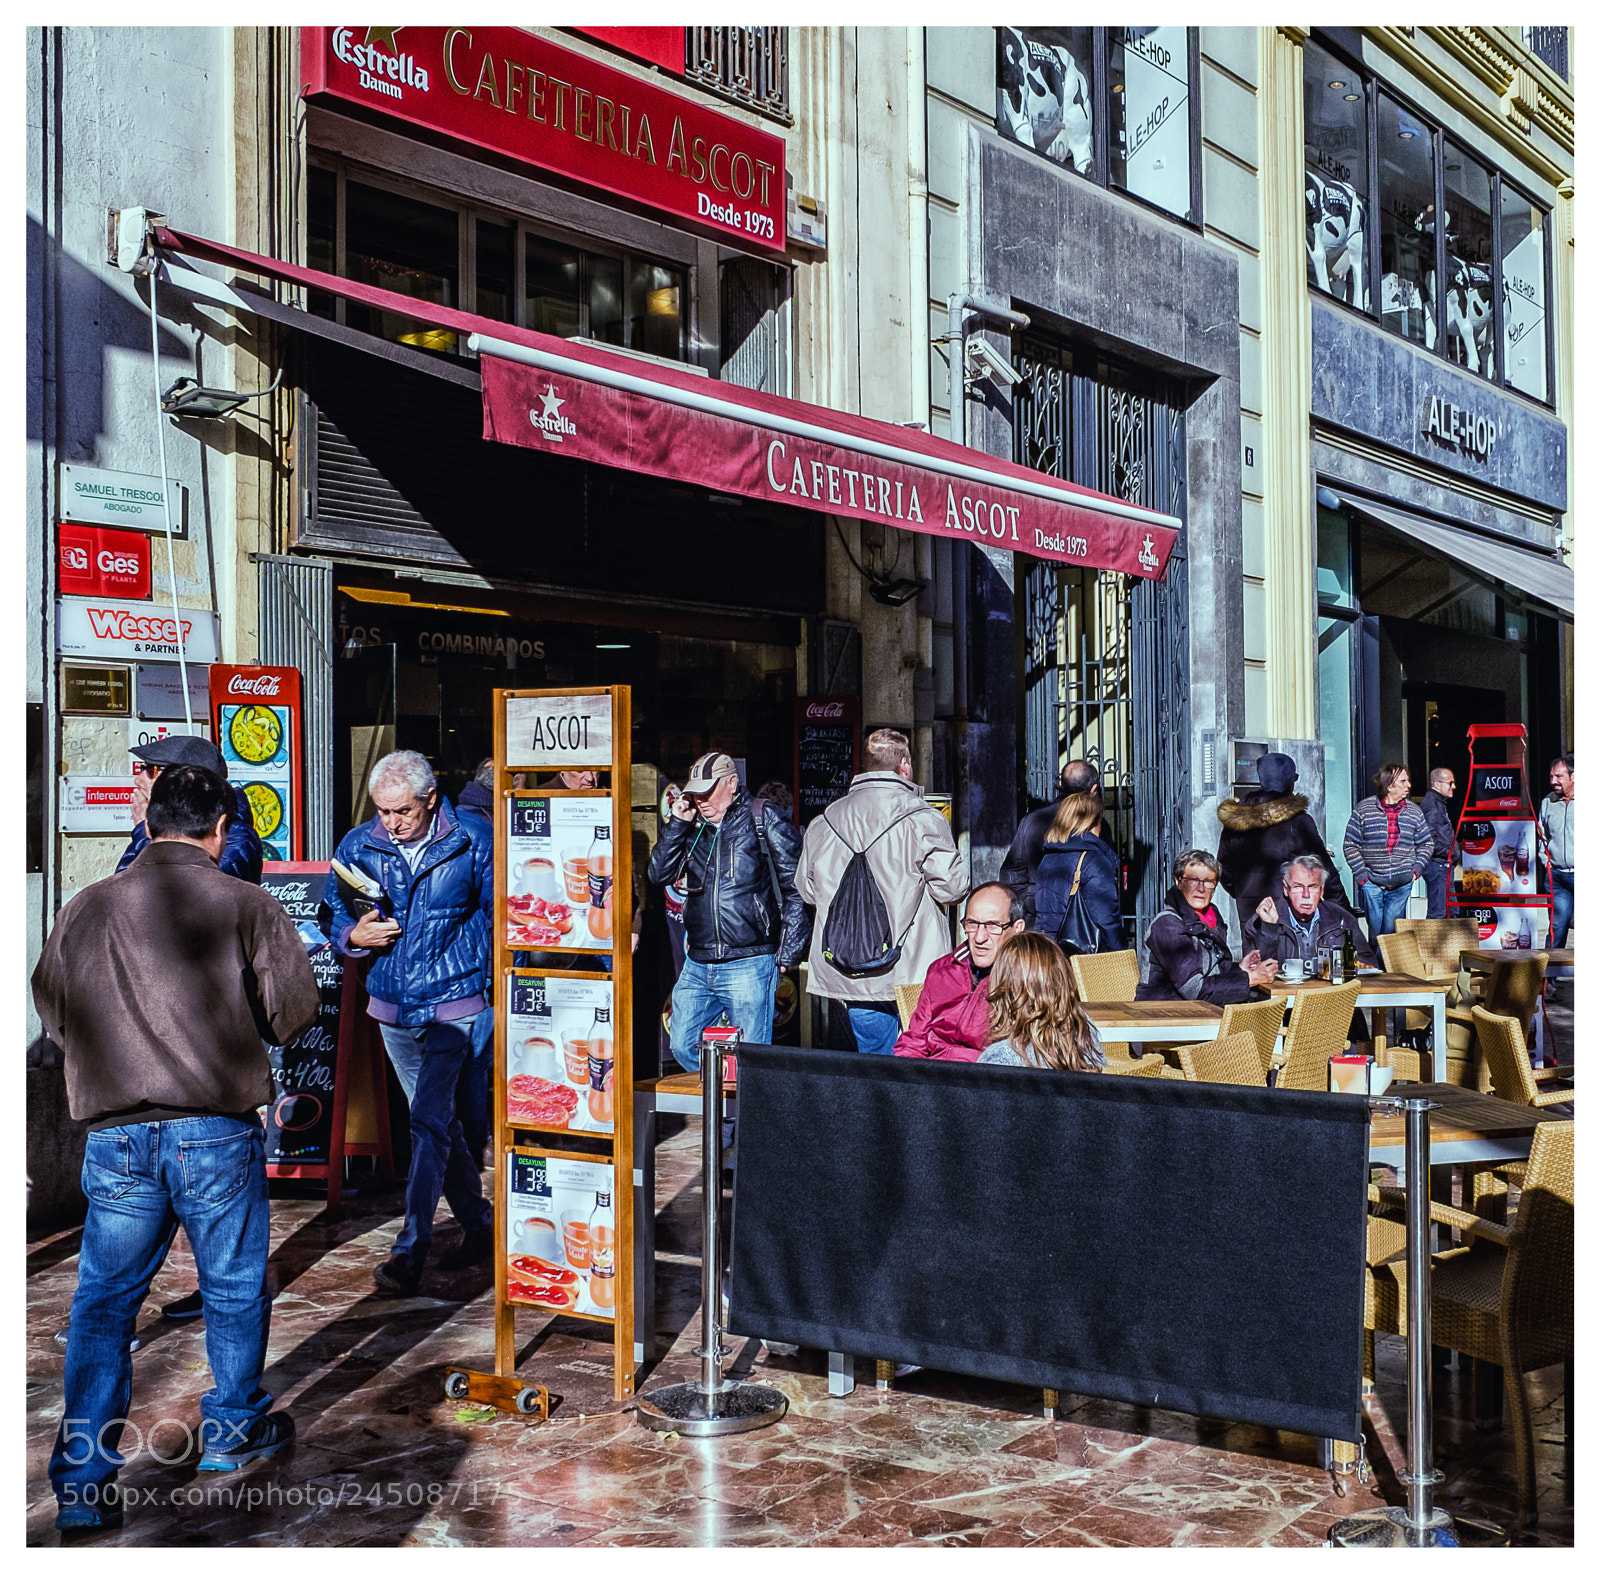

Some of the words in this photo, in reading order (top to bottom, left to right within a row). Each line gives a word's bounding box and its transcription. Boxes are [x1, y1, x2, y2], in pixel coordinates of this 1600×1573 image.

[332, 27, 429, 92] Estrella
[1125, 27, 1171, 69] ALE-HOP
[358, 70, 402, 99] Damm
[443, 27, 656, 165] CAFETERIA
[667, 114, 775, 206] ASCOT
[1317, 150, 1350, 182] ALE-HOP
[697, 192, 742, 228] Desde
[743, 209, 775, 239] 1973
[530, 408, 576, 436] Estrella
[1429, 395, 1497, 456] ALE-HOP
[1246, 450, 1252, 466] 6
[74, 482, 118, 496] SAMUEL
[767, 439, 924, 524] CAFETERIA
[945, 483, 1020, 541] ASCOT
[1035, 528, 1066, 553] Desde
[1066, 536, 1087, 558] 1973
[104, 502, 142, 514] ABOGADO
[97, 550, 139, 575] Ges
[111, 576, 136, 584] PLANTA
[87, 608, 192, 643] Wesser
[134, 644, 142, 652] &
[418, 632, 546, 659] COMBINADOS
[228, 674, 281, 696] Coca-Cola
[532, 716, 592, 750] ASCOT
[1484, 776, 1513, 790] ASCOT
[518, 800, 545, 808] DESAYUNO
[518, 1158, 546, 1168] DESAYUNO
